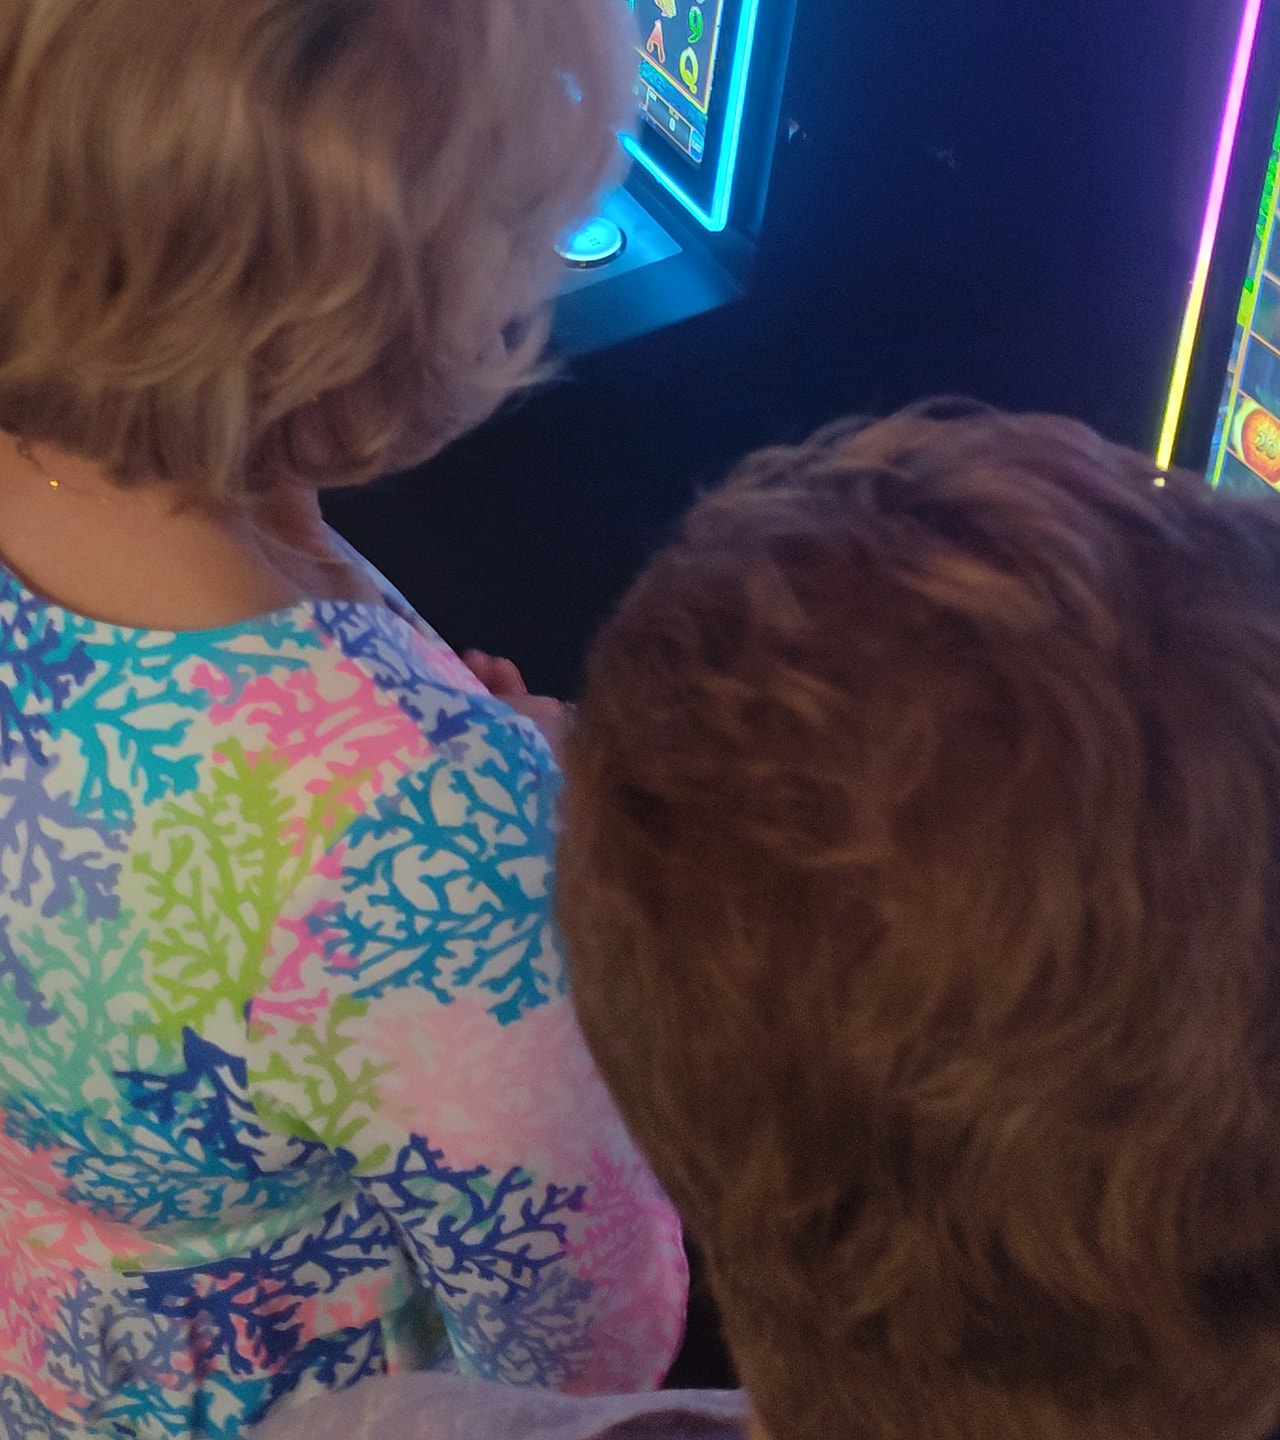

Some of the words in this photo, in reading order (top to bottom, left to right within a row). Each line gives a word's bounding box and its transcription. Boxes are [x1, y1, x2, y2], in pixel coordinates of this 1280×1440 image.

[647, 19, 665, 64] A
[688, 6, 703, 43] 9
[680, 47, 698, 94] Q
